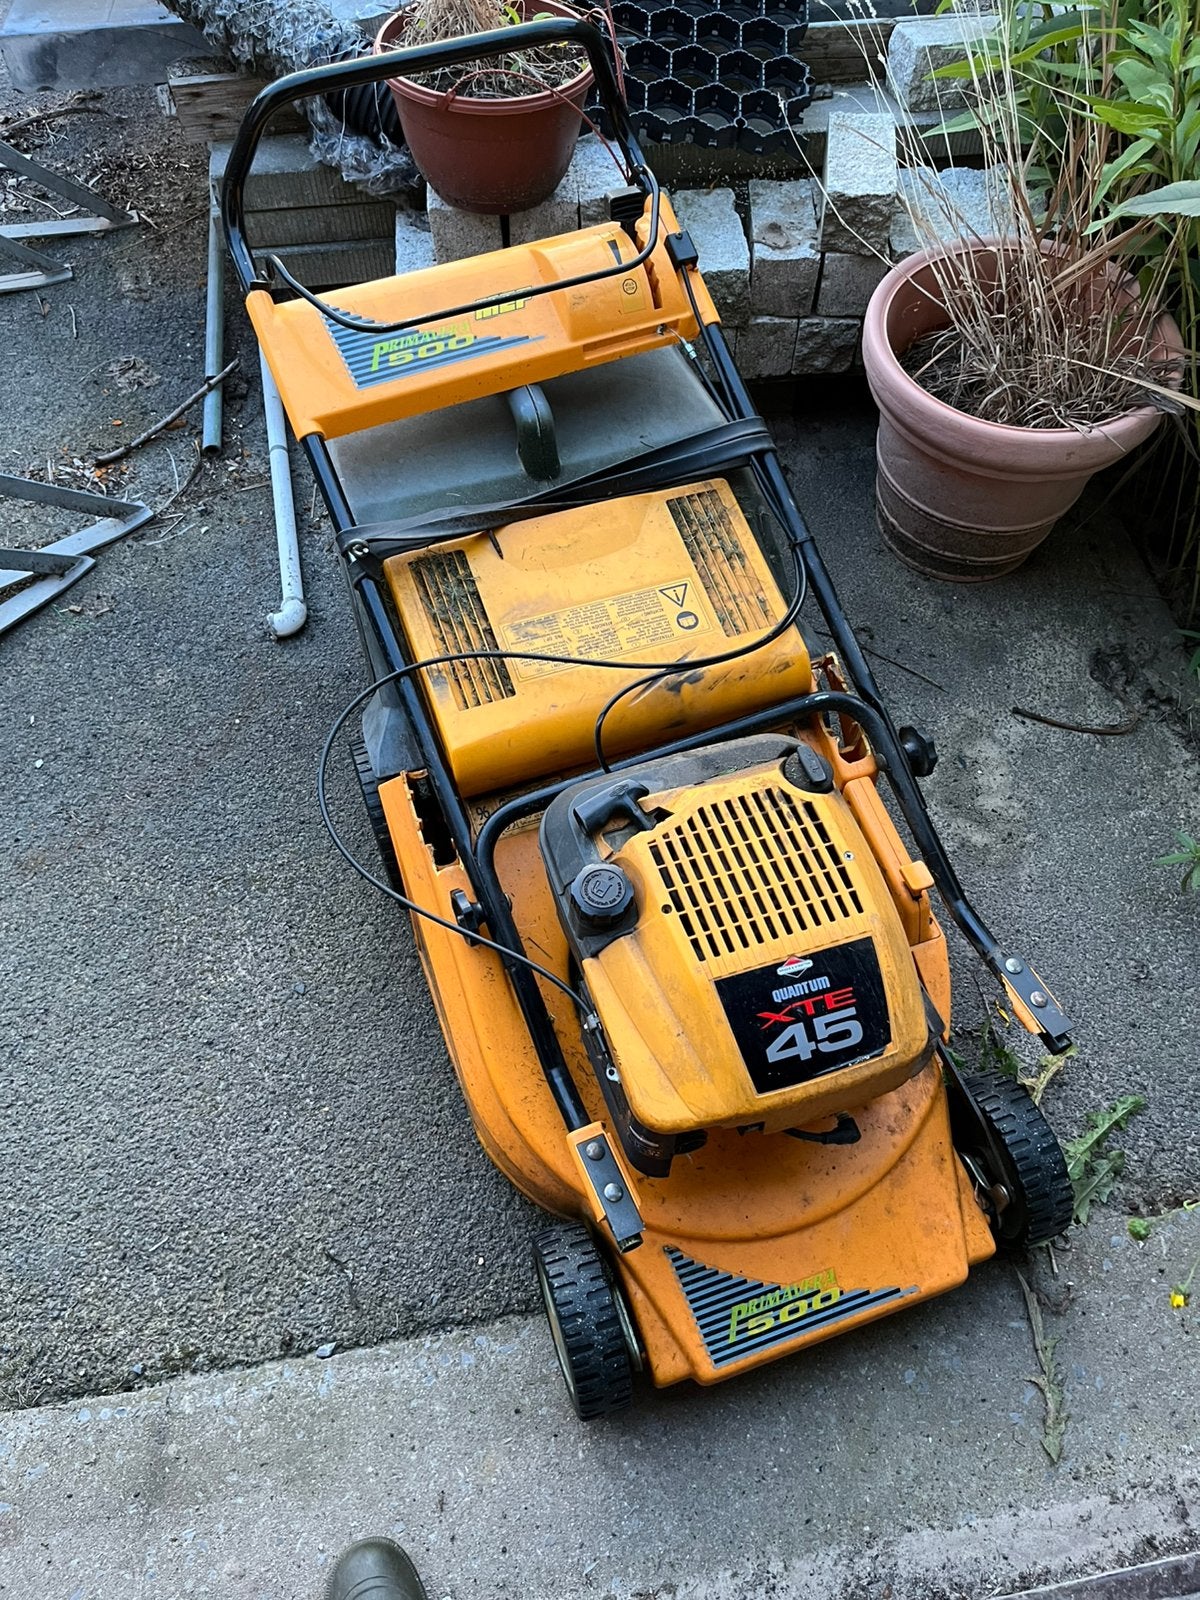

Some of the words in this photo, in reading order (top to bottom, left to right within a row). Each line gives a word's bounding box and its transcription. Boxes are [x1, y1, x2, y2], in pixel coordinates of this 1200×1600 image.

[371, 320, 471, 372] PRIMAVERA
[388, 334, 476, 367] 500
[756, 987, 856, 1030] XTE
[772, 976, 830, 1002] QUANTUM
[765, 1007, 863, 1063] 45
[728, 1267, 837, 1344] PRIMAVERA
[747, 1287, 840, 1336] 500
